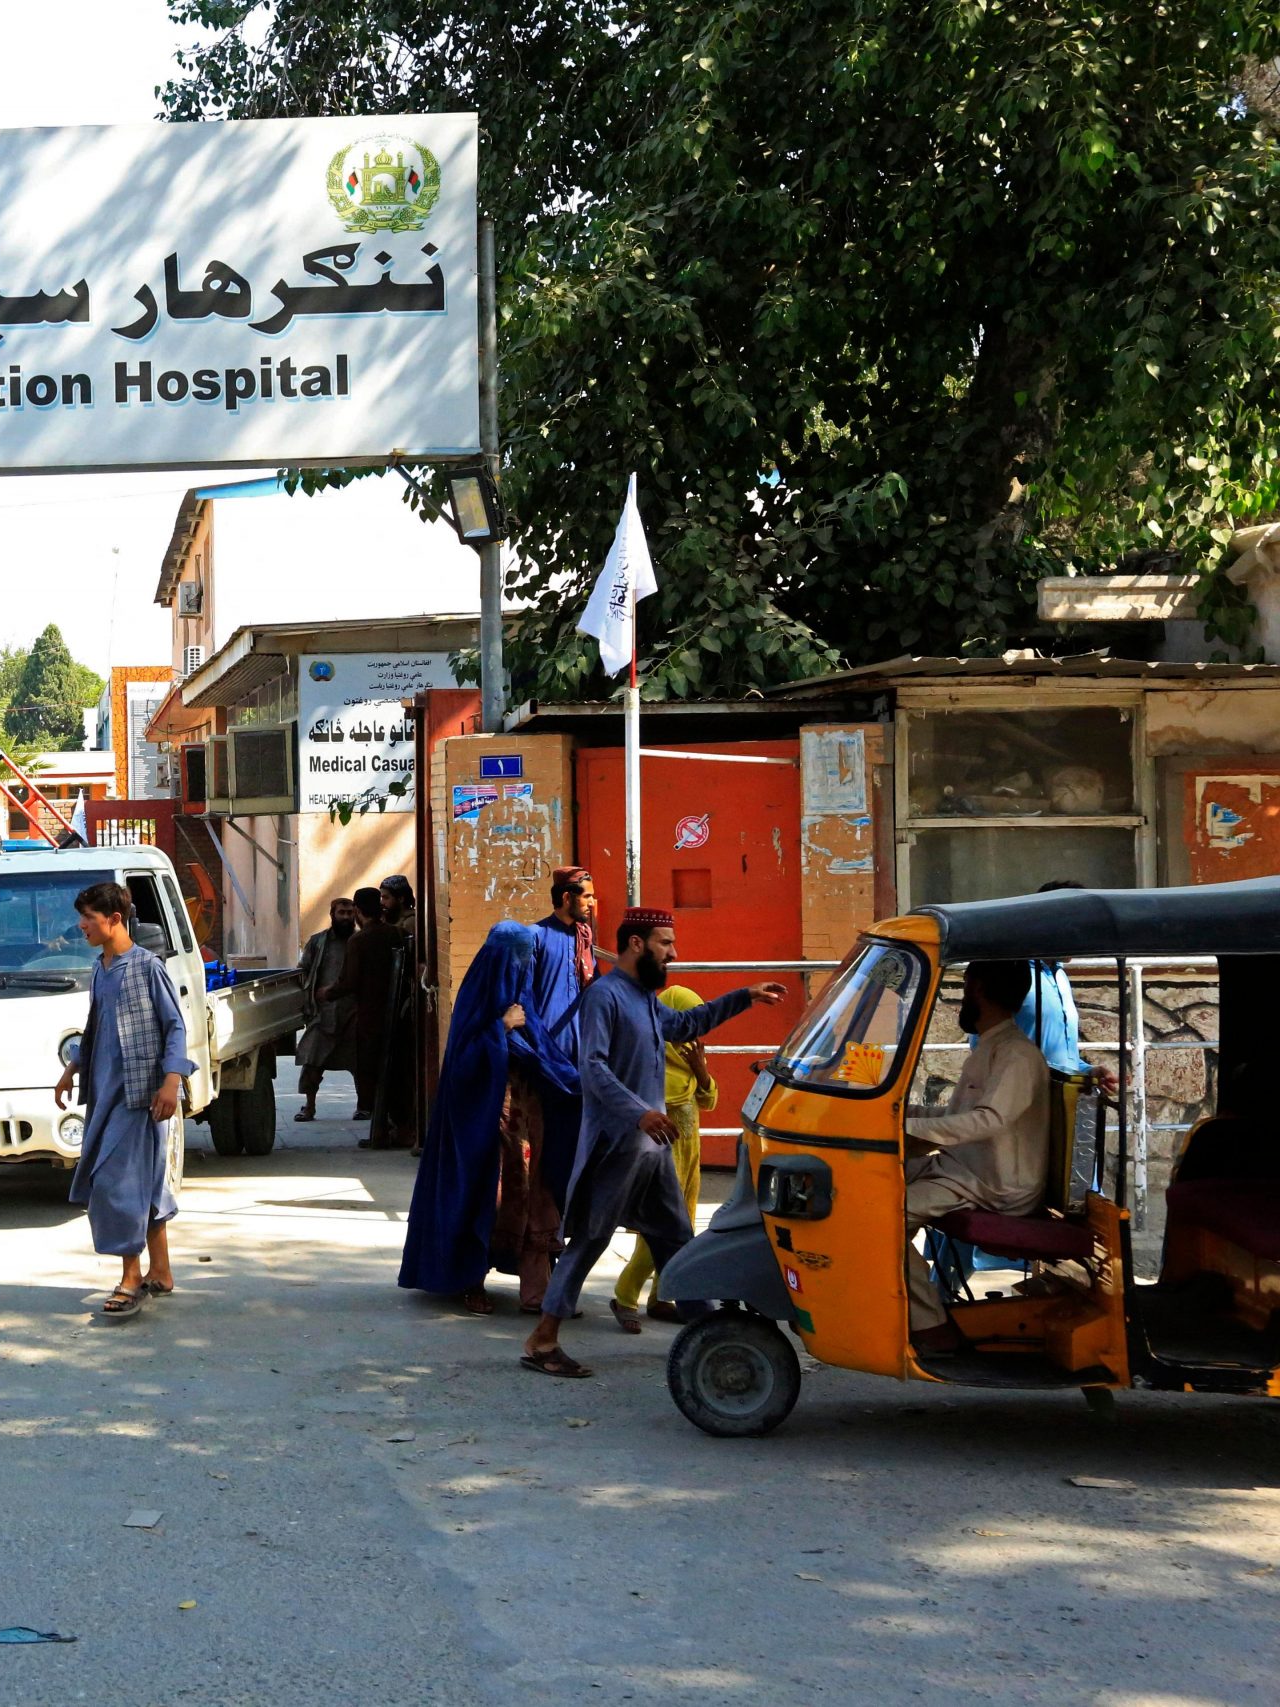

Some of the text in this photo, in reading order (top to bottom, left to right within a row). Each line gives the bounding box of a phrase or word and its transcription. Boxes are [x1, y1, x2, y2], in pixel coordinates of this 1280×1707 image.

[115, 354, 349, 411] Hospital
[349, 719, 386, 747] عاجله
[309, 754, 415, 772] Medical Casua
